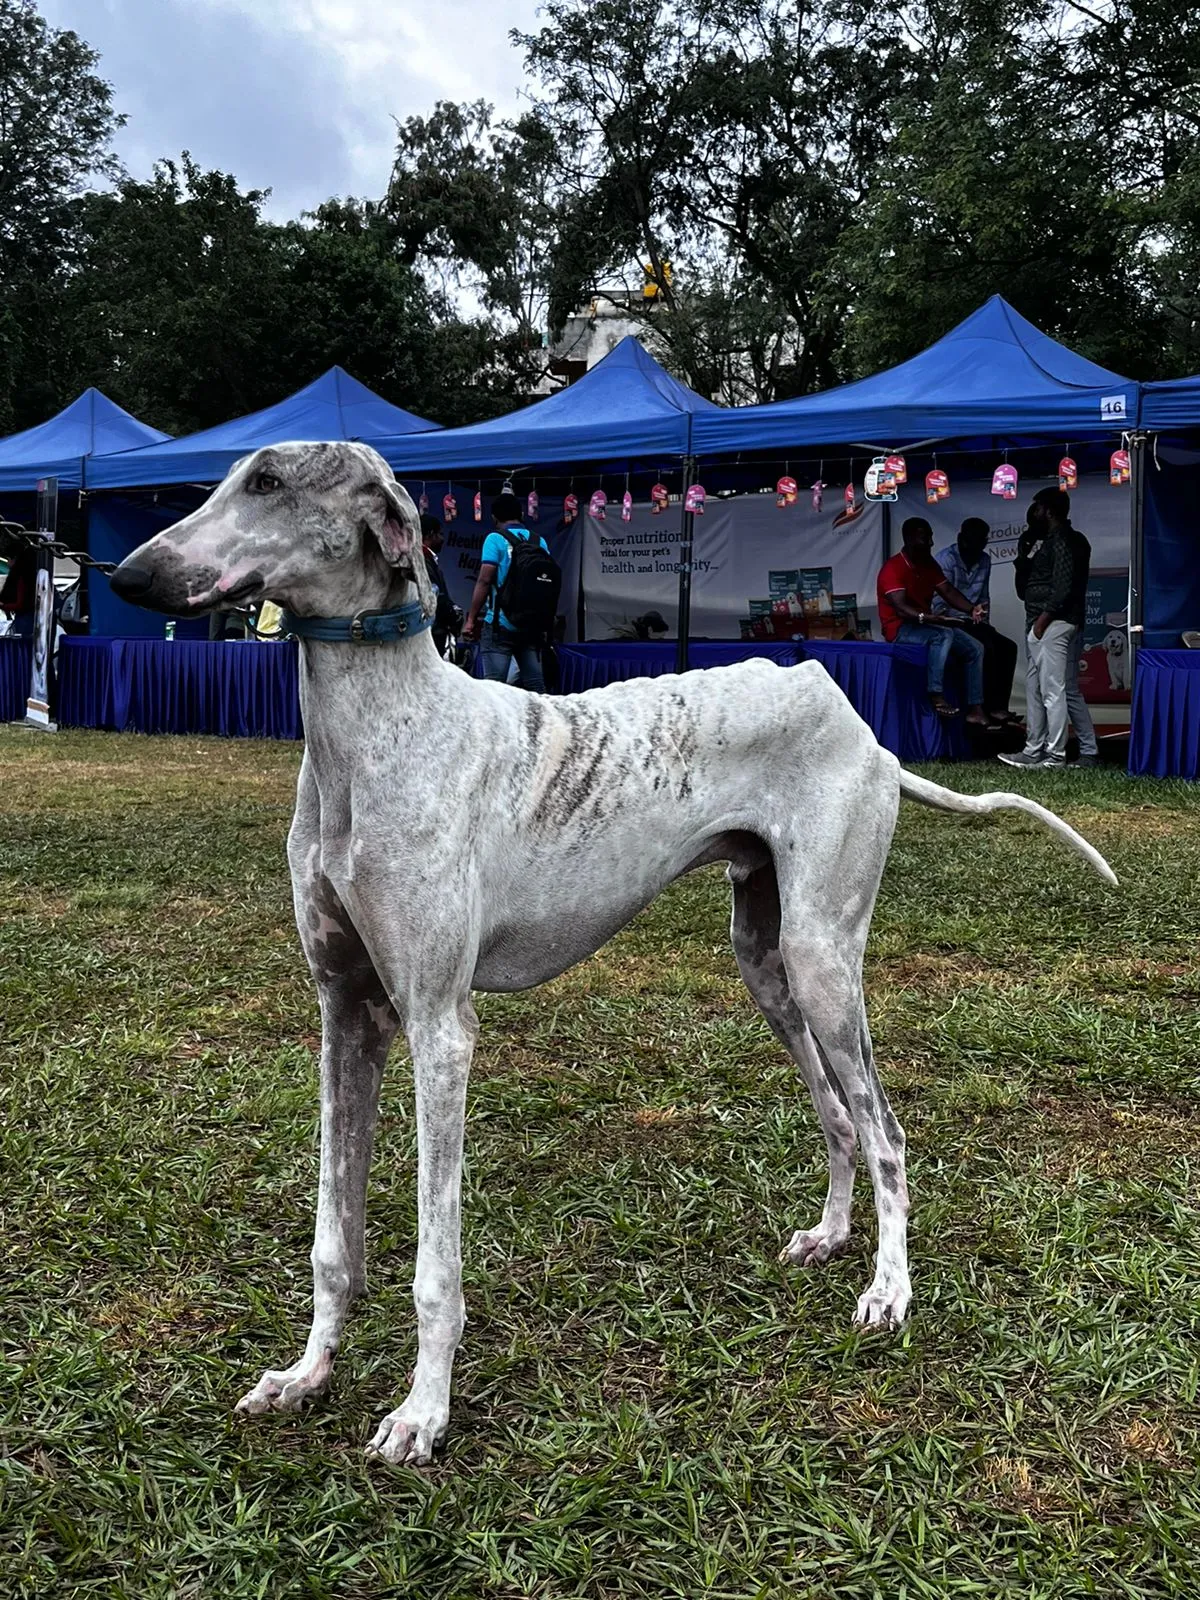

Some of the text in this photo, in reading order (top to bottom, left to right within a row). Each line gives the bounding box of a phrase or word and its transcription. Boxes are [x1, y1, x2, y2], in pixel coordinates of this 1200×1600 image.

[1104, 402, 1122, 414] 16
[990, 523, 1027, 539] roduc
[447, 530, 482, 549] Healt
[600, 537, 625, 547] Proper
[600, 547, 671, 558] vital for your pet's
[988, 547, 1017, 559] New
[601, 561, 635, 573] health
[637, 564, 652, 573] and
[1087, 604, 1100, 616] hy
[1085, 615, 1104, 625] ood
